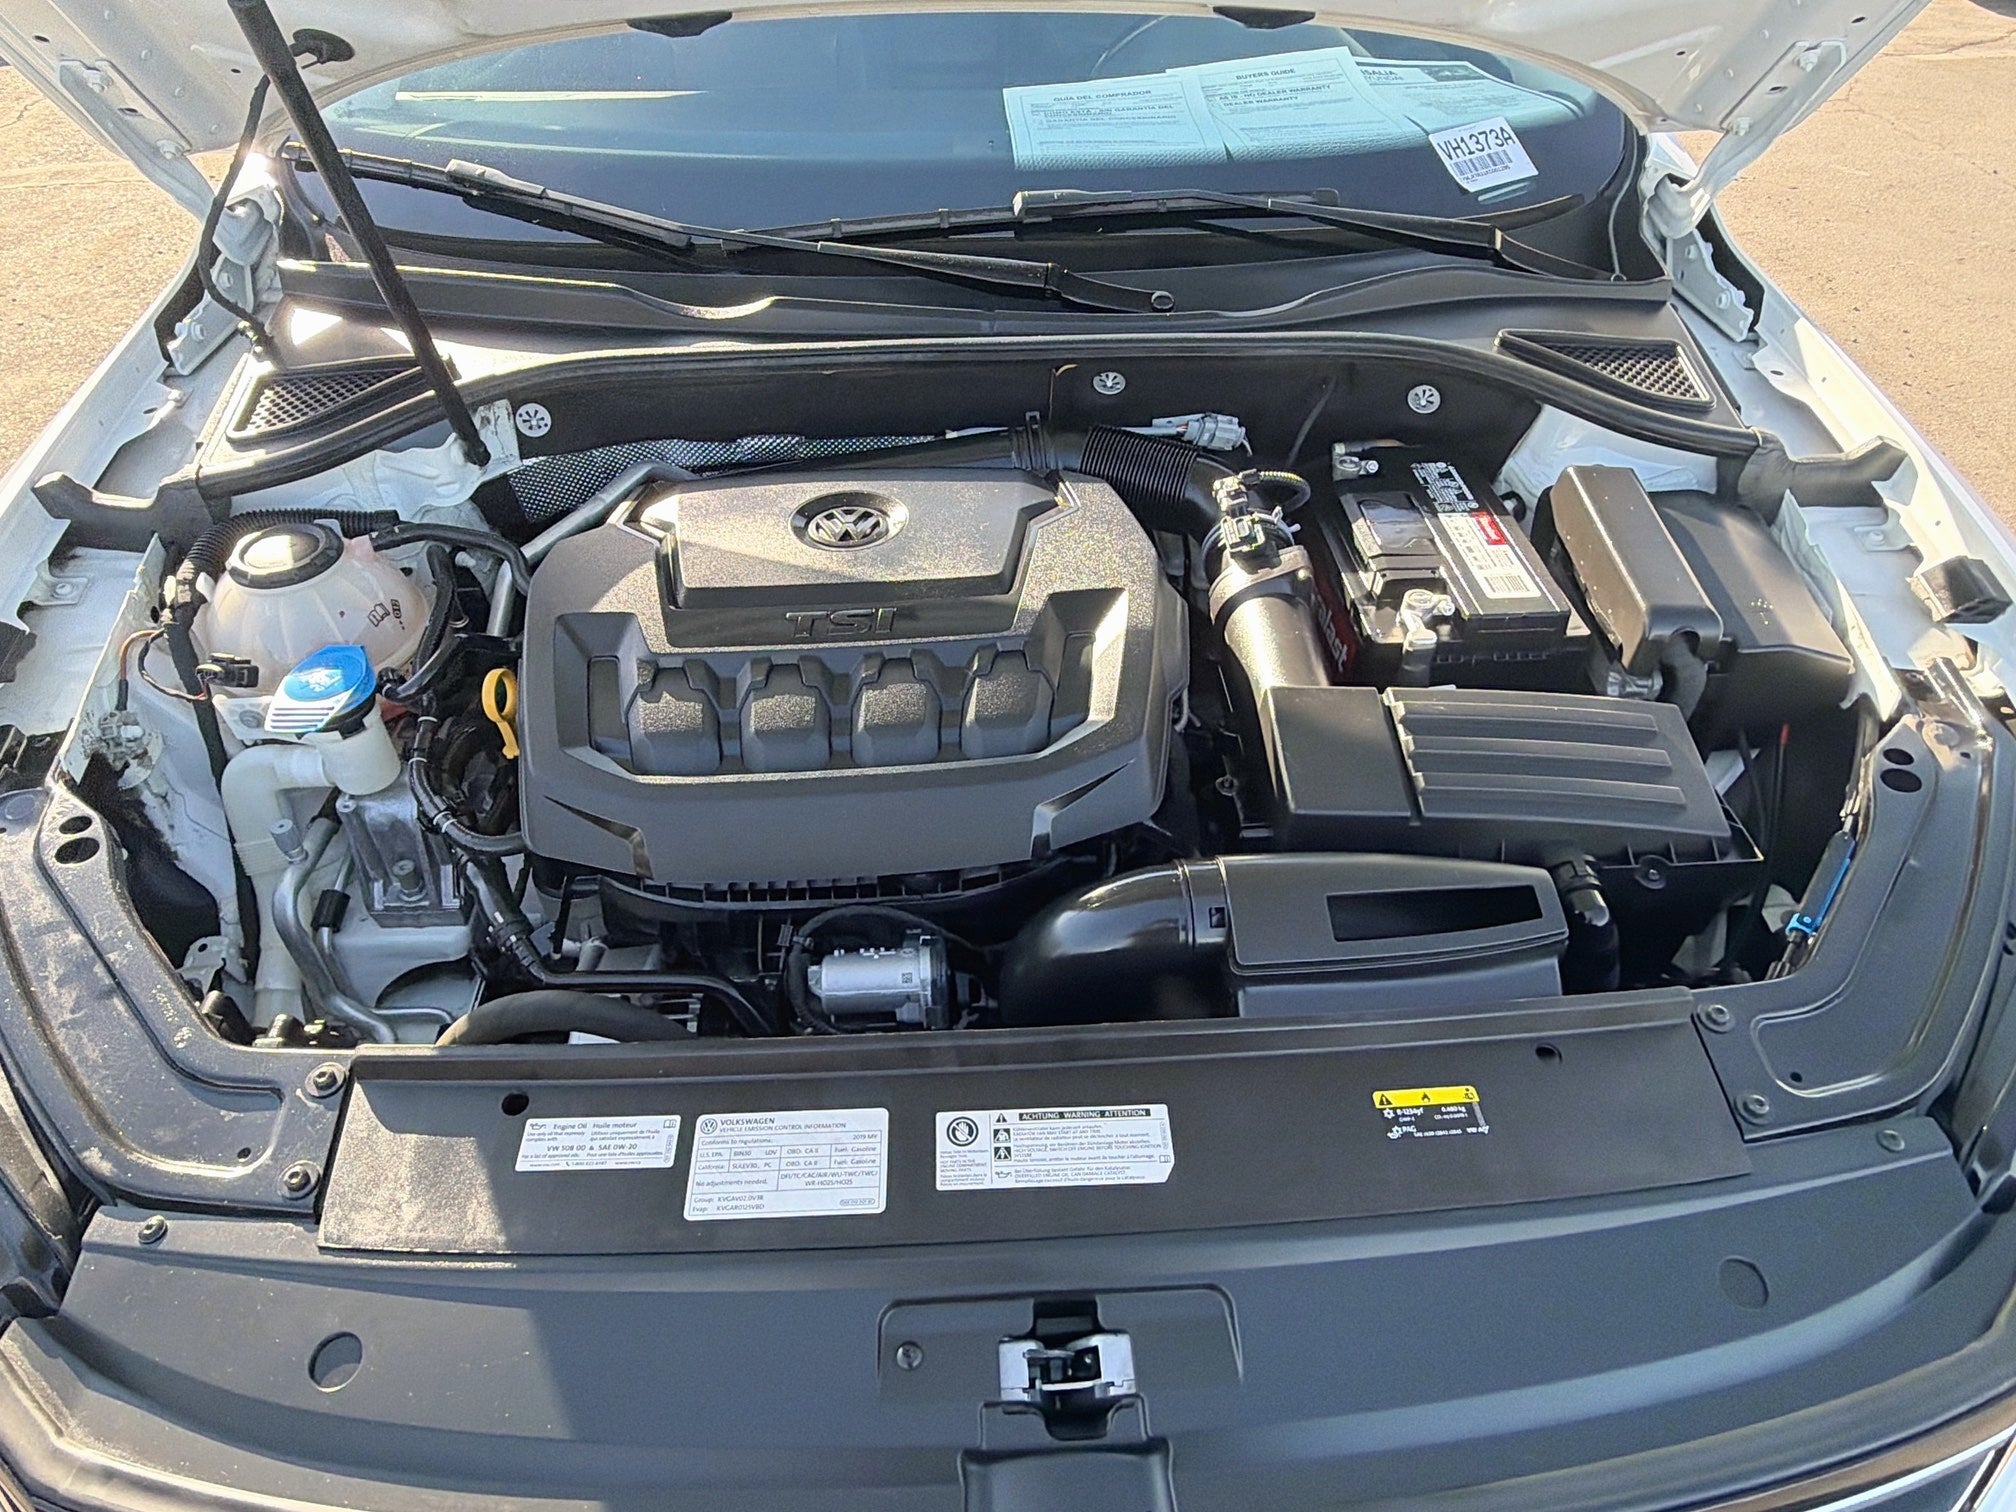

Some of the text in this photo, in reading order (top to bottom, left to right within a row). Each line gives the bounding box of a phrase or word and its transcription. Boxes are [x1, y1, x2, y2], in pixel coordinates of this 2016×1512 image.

[1236, 68, 1295, 80] BUYERS GUIDE
[1096, 90, 1151, 98] COMPRADOR
[1437, 127, 1515, 160] VH1373A
[785, 607, 897, 638] TSI
[1022, 1112, 1060, 1120] ACHTUNG
[1063, 1111, 1101, 1119] WARNING
[720, 1118, 775, 1126] VOLKSWAGEN
